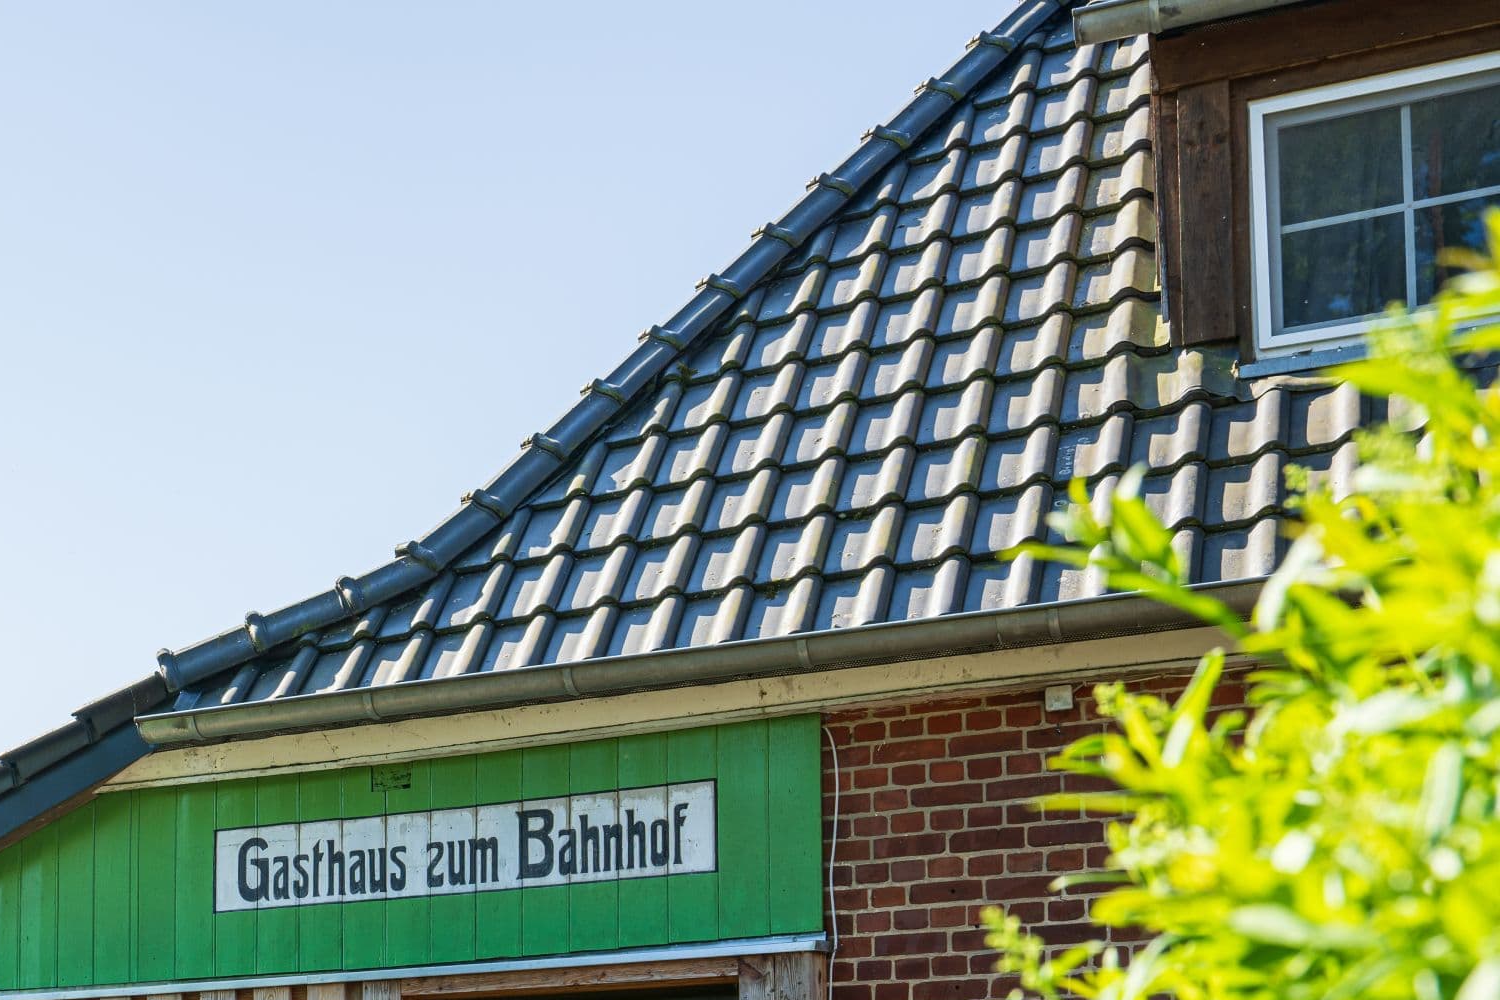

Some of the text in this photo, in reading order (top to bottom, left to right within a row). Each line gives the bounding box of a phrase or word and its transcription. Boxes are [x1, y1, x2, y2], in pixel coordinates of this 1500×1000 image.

[237, 802, 689, 902] Gasthaus zum Bahnhof
